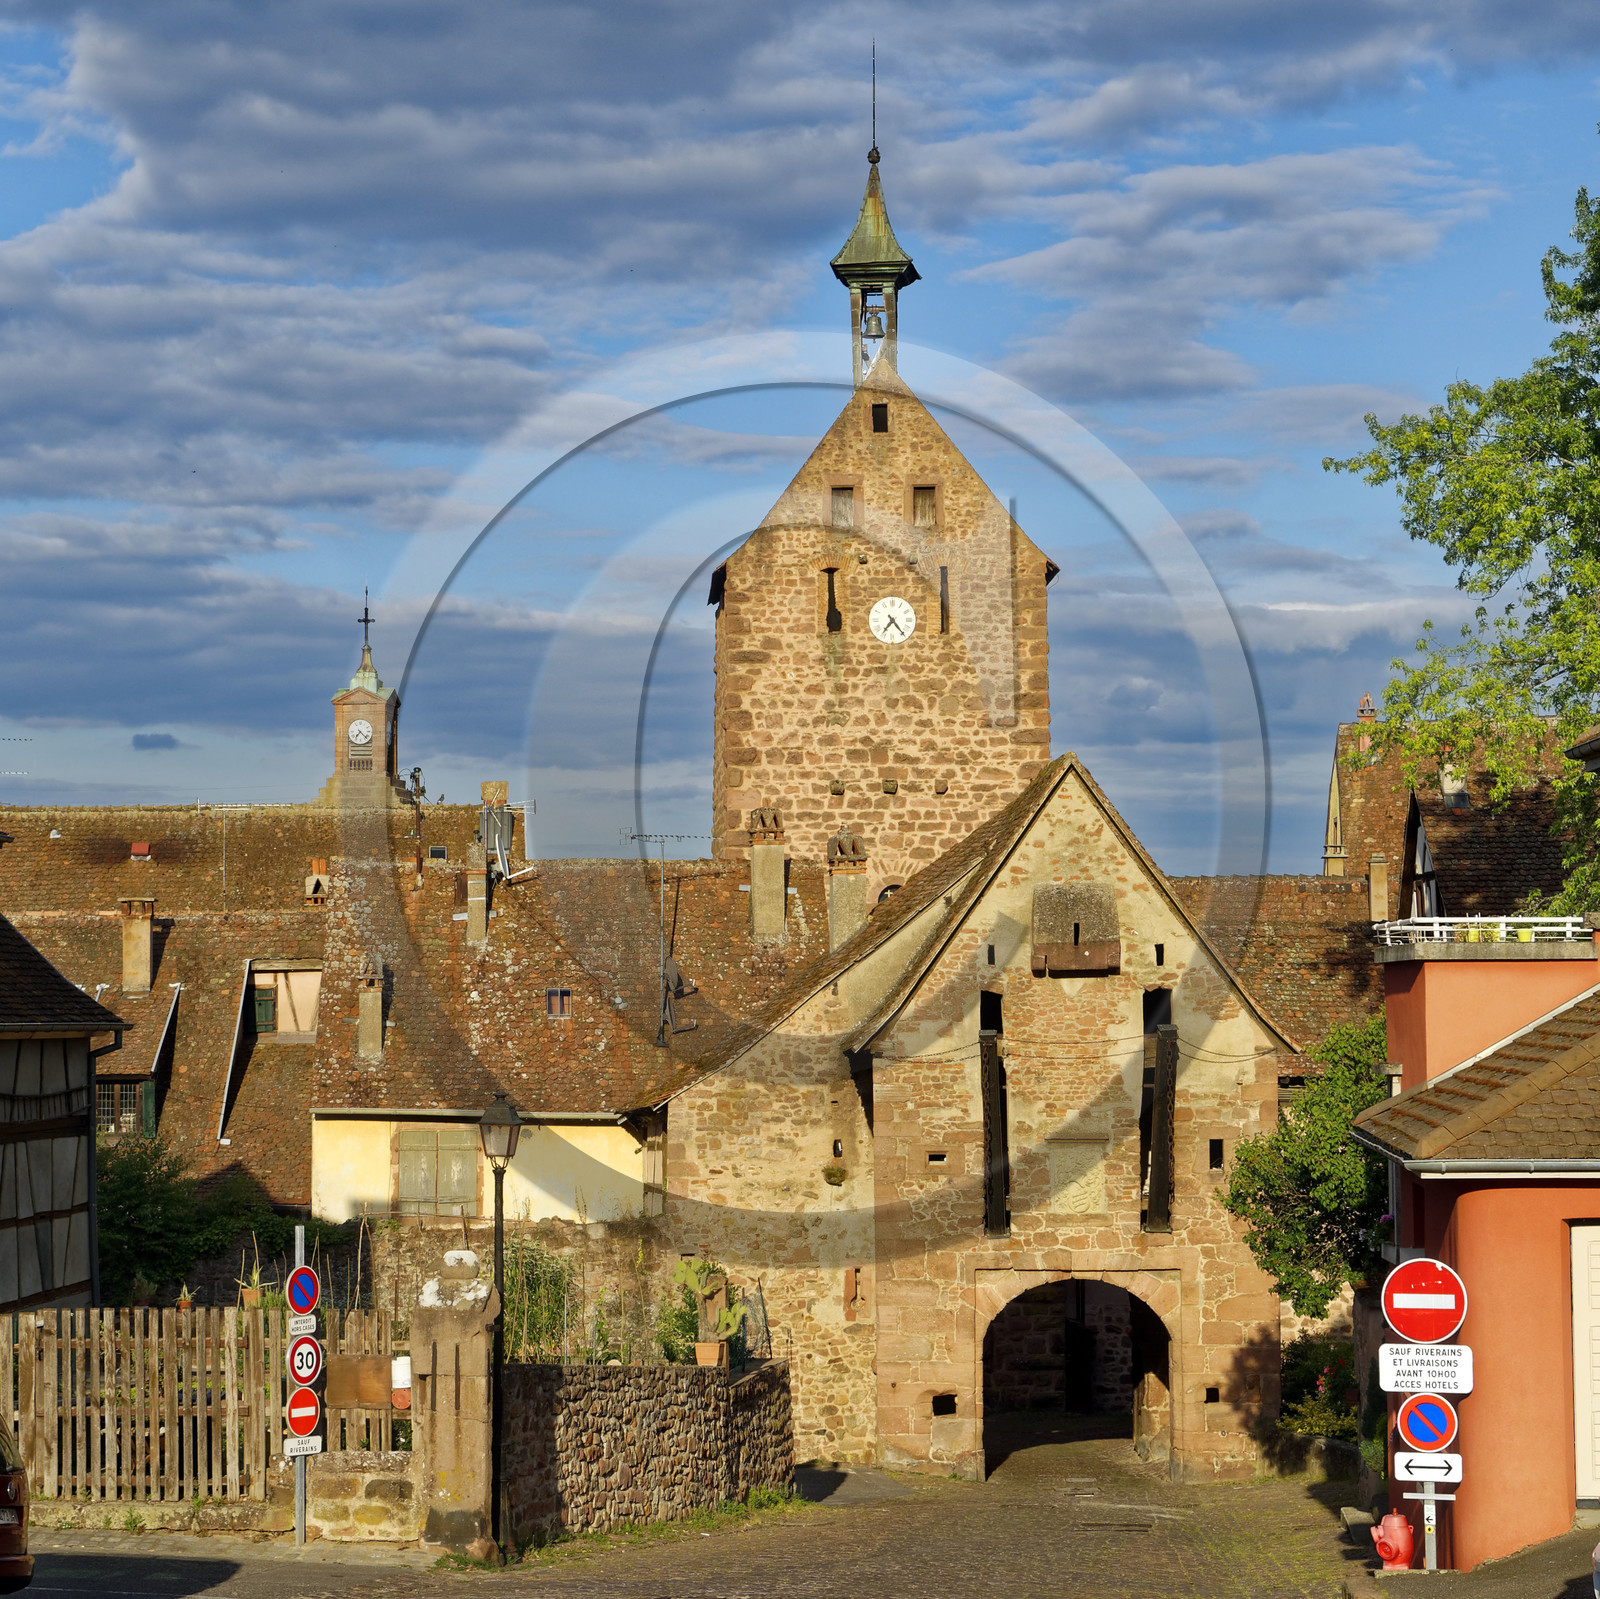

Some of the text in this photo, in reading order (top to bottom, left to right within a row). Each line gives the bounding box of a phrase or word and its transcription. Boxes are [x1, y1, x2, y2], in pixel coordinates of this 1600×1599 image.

[1389, 1347, 1463, 1357] SAUF RIVERAINS
[296, 1351, 315, 1371] 30
[1392, 1358, 1459, 1367] ET LIVRAISONS
[1396, 1369, 1457, 1378] AVANT 10H00
[1393, 1380, 1459, 1389] ACCES HOTELS
[289, 1445, 318, 1454] RIVERAINS
